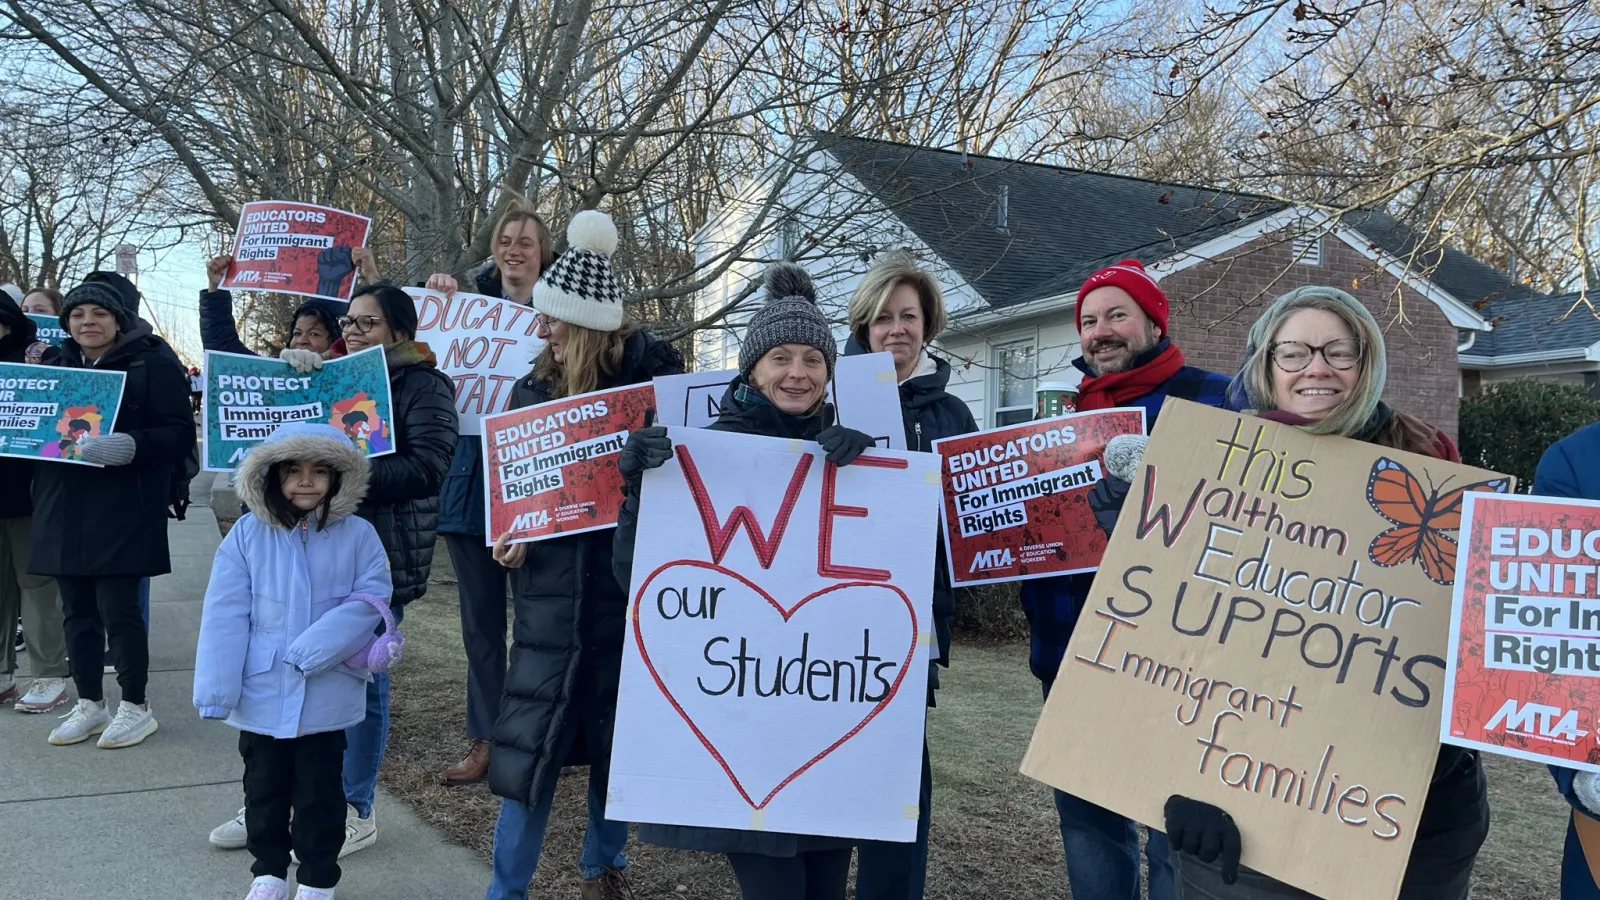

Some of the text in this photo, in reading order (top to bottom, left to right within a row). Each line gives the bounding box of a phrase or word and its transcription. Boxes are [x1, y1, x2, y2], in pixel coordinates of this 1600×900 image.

[243, 222, 289, 234] UNITED
[246, 210, 326, 223] EDUCATORS
[239, 249, 276, 260] Rights
[242, 234, 328, 248] For Immigrant
[232, 270, 261, 283] MTA
[442, 336, 517, 370] NOT
[218, 375, 311, 390] PROTECT
[219, 391, 264, 405] OUR
[224, 406, 320, 423] Immigrant
[494, 400, 608, 446] EDUCATORS
[498, 431, 566, 462] UNITED
[502, 434, 625, 480] For Immigrant
[948, 426, 1077, 474] EDUCATORS
[1216, 417, 1317, 502] this
[505, 473, 561, 500] Rights
[952, 460, 1028, 492] UNITED
[958, 466, 1096, 512] For Immigrant
[509, 510, 552, 533] MTA
[675, 444, 909, 582] WE
[962, 508, 1024, 533] Rights
[1135, 464, 1350, 556] Waltham
[1026, 548, 1056, 556] EDUCATION
[1491, 527, 1600, 560] EDUC
[969, 548, 1016, 573] MTA
[1020, 556, 1046, 564] WORKERS
[1193, 521, 1422, 630] Educator
[1489, 561, 1600, 595] UNIT
[657, 586, 727, 620] our
[1494, 596, 1561, 628] For
[696, 628, 897, 702] Students
[1074, 609, 1303, 727] Immigrant
[1493, 634, 1600, 674] Right
[1483, 698, 1589, 741] MTA
[1196, 709, 1407, 841] families
